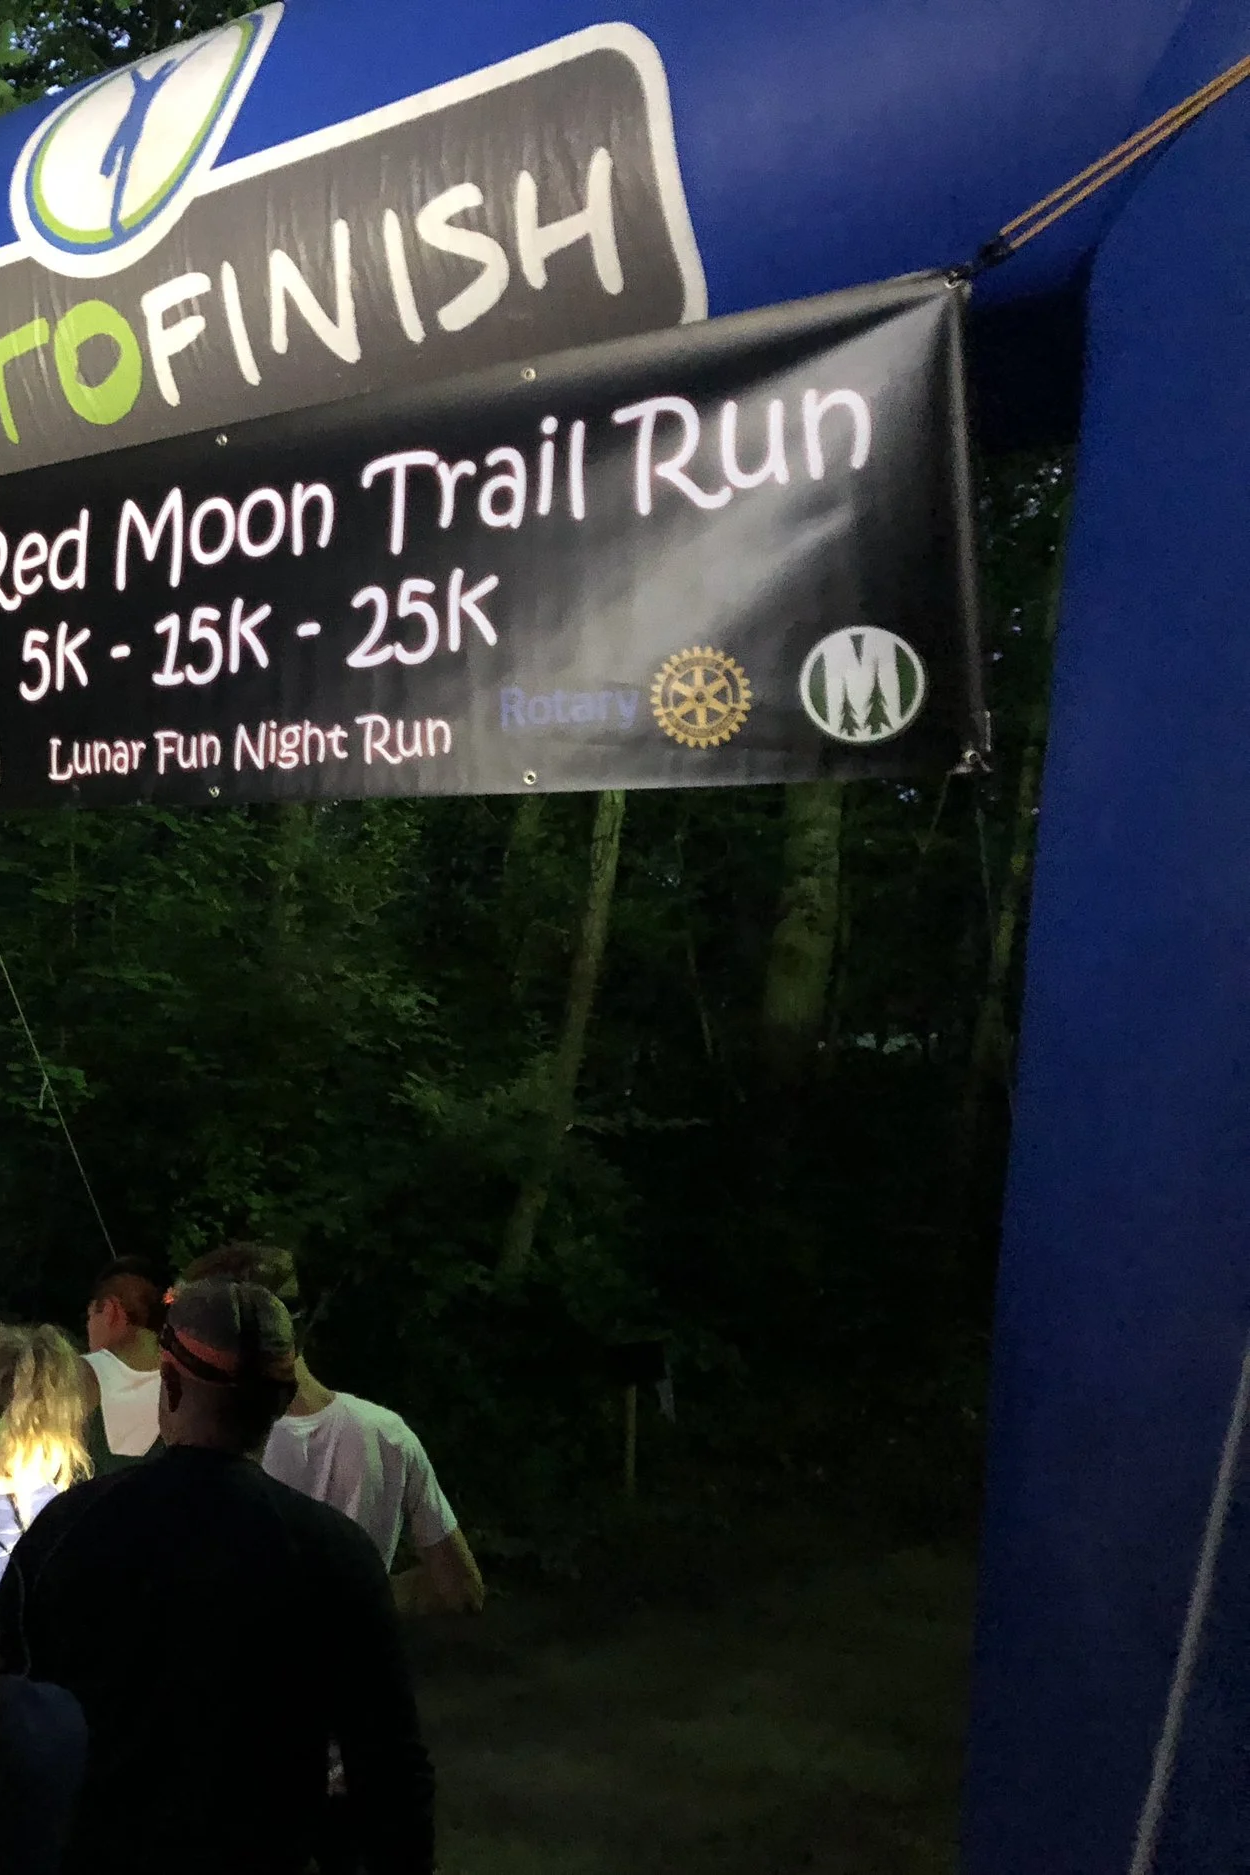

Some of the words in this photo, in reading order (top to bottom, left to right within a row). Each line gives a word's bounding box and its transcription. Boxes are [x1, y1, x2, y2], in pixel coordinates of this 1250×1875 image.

[115, 482, 334, 591] Moon
[362, 415, 585, 555] Trail
[613, 388, 872, 516] Run
[19, 622, 90, 701] 5K
[110, 643, 131, 660] -
[152, 598, 271, 686] 15K
[296, 621, 321, 637] -
[346, 568, 498, 668] 25K
[49, 737, 146, 782] Lunar
[154, 730, 221, 774] Fun
[234, 718, 348, 772] Night
[355, 713, 452, 765] Run
[500, 687, 640, 731] Rotary
